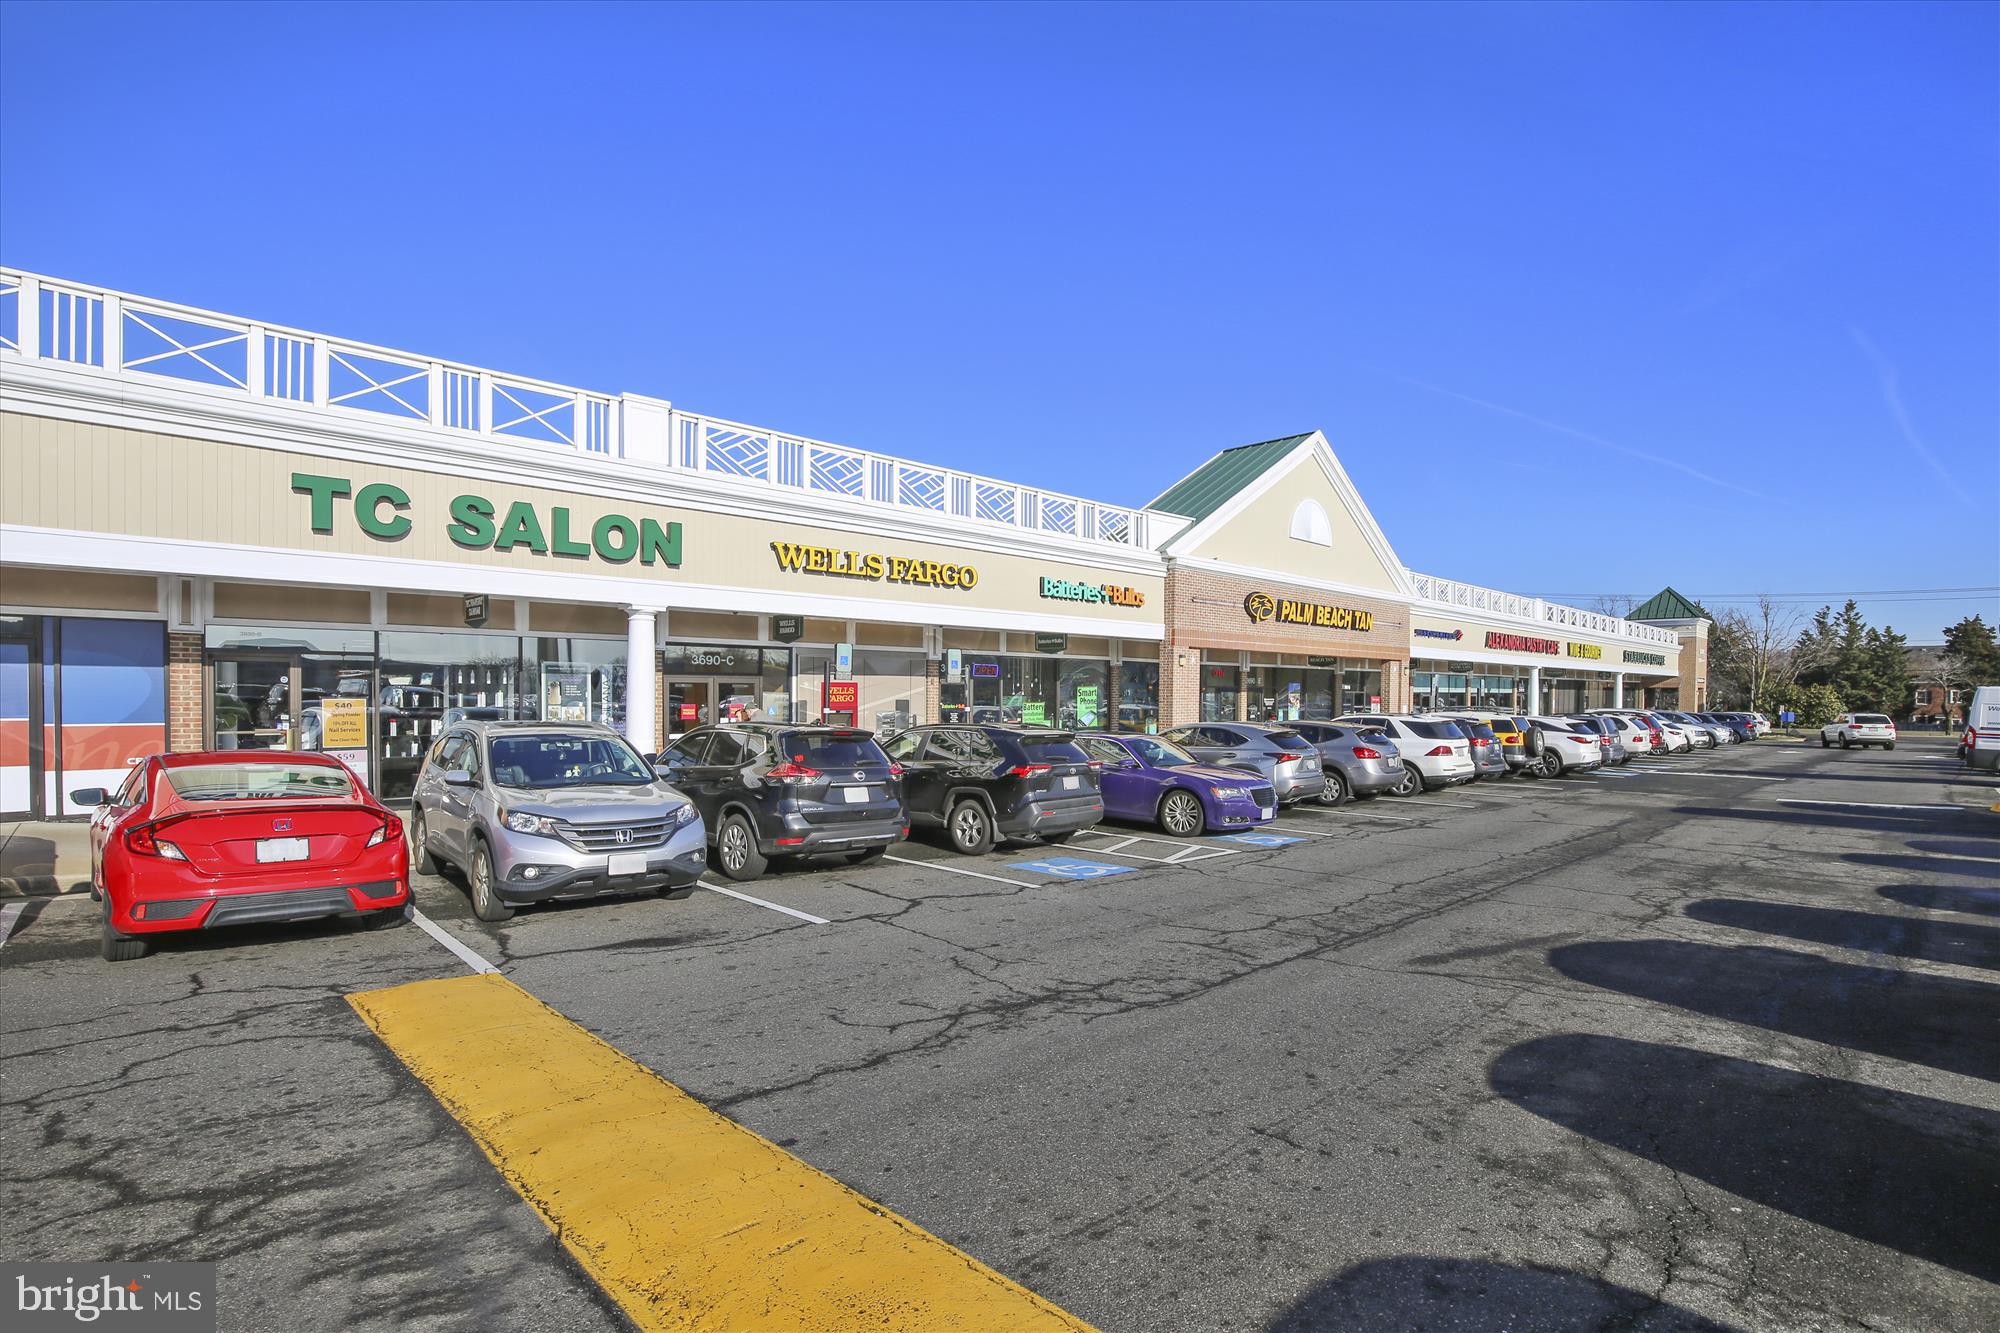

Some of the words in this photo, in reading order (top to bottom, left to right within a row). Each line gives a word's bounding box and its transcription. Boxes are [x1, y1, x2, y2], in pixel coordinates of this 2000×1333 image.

[291, 472, 413, 539] TC
[446, 494, 682, 566] SALON
[772, 541, 885, 578] WELLS
[888, 556, 979, 590] FARGO
[1280, 600, 1315, 624] PALM
[1316, 605, 1352, 629] BEACH
[1354, 611, 1374, 631] TAN
[691, 655, 735, 666] 3690-C
[1078, 688, 1097, 697] Smart
[334, 702, 353, 710] $40
[1080, 697, 1097, 705] Phone
[1023, 703, 1045, 711] Battery
